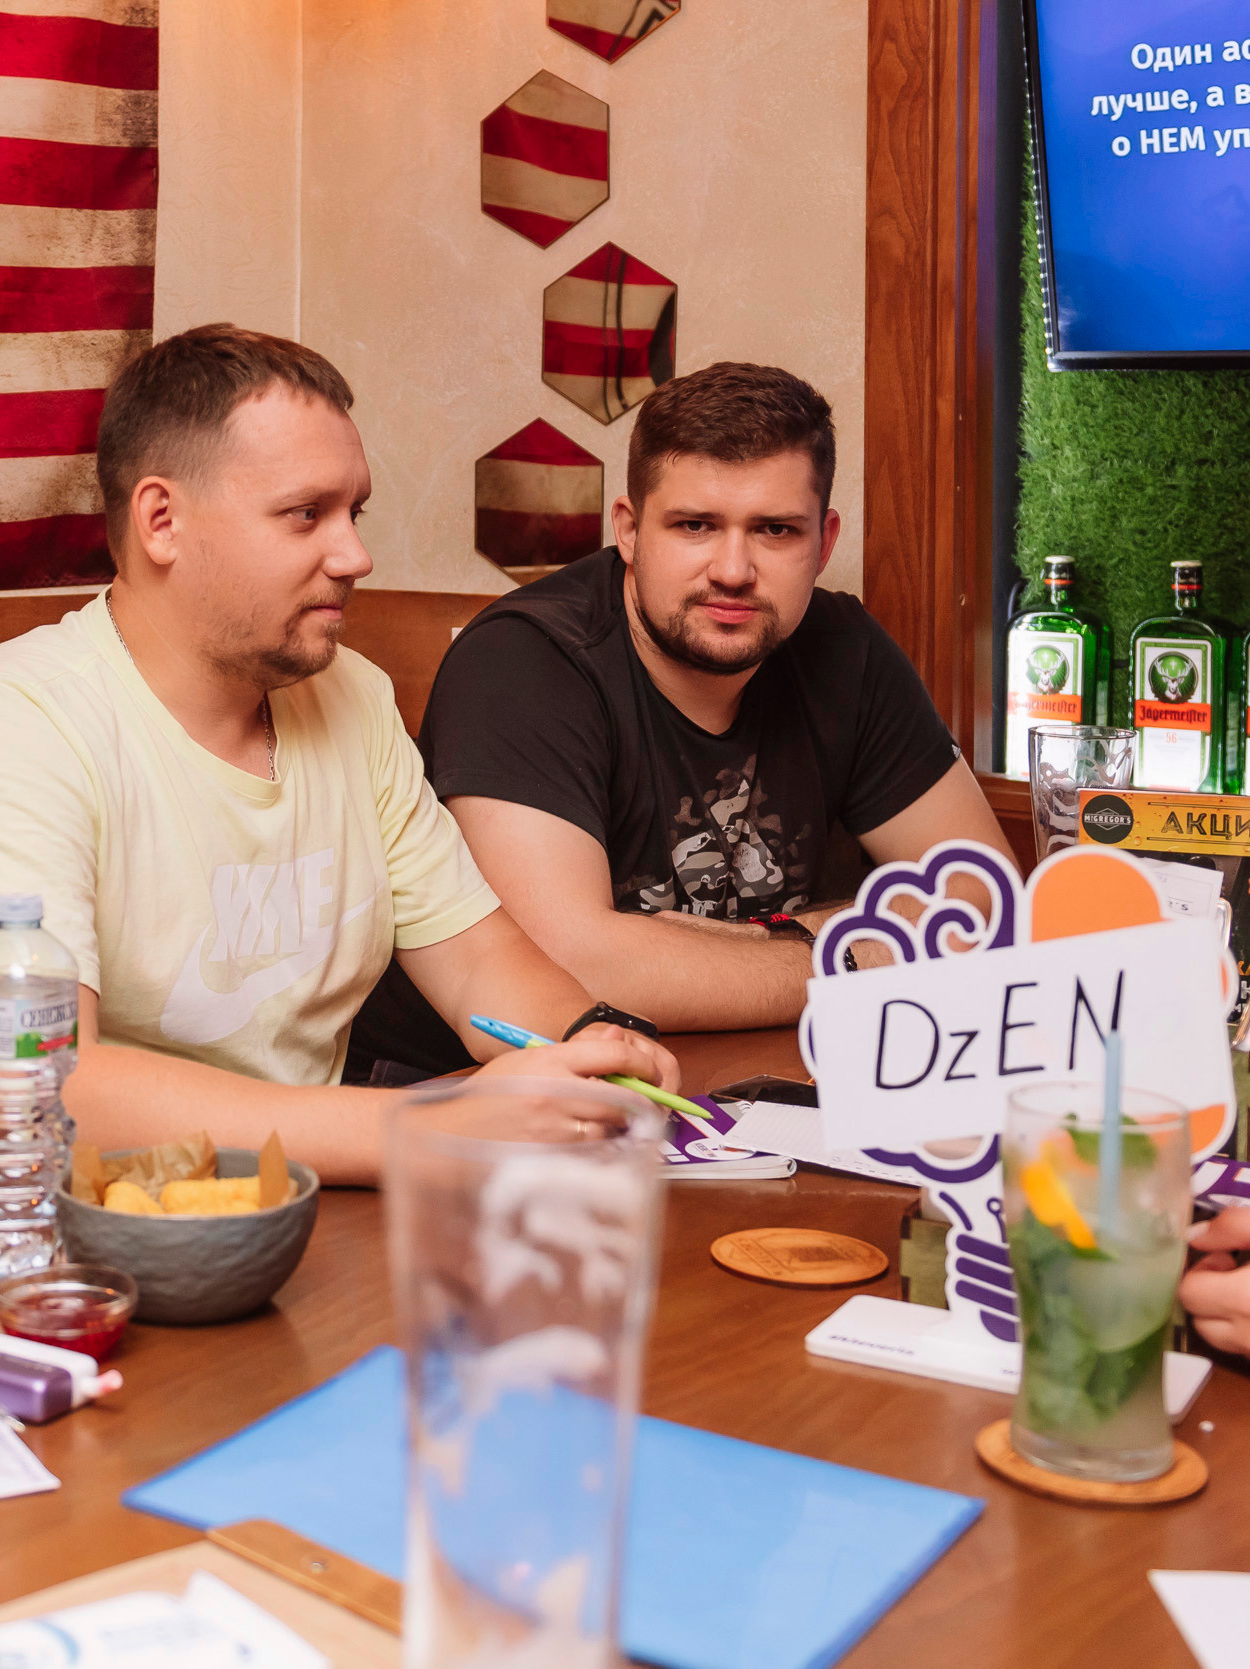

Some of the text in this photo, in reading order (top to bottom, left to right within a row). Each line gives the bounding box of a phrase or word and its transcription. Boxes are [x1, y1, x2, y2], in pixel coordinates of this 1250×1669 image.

[1131, 42, 1212, 72] Один
[1091, 88, 1198, 121] лучше,
[1206, 85, 1225, 107] а
[1111, 125, 1250, 157] о НЕМ уп
[1161, 811, 1250, 840] АКЦИ
[874, 969, 1126, 1090] DzEN
